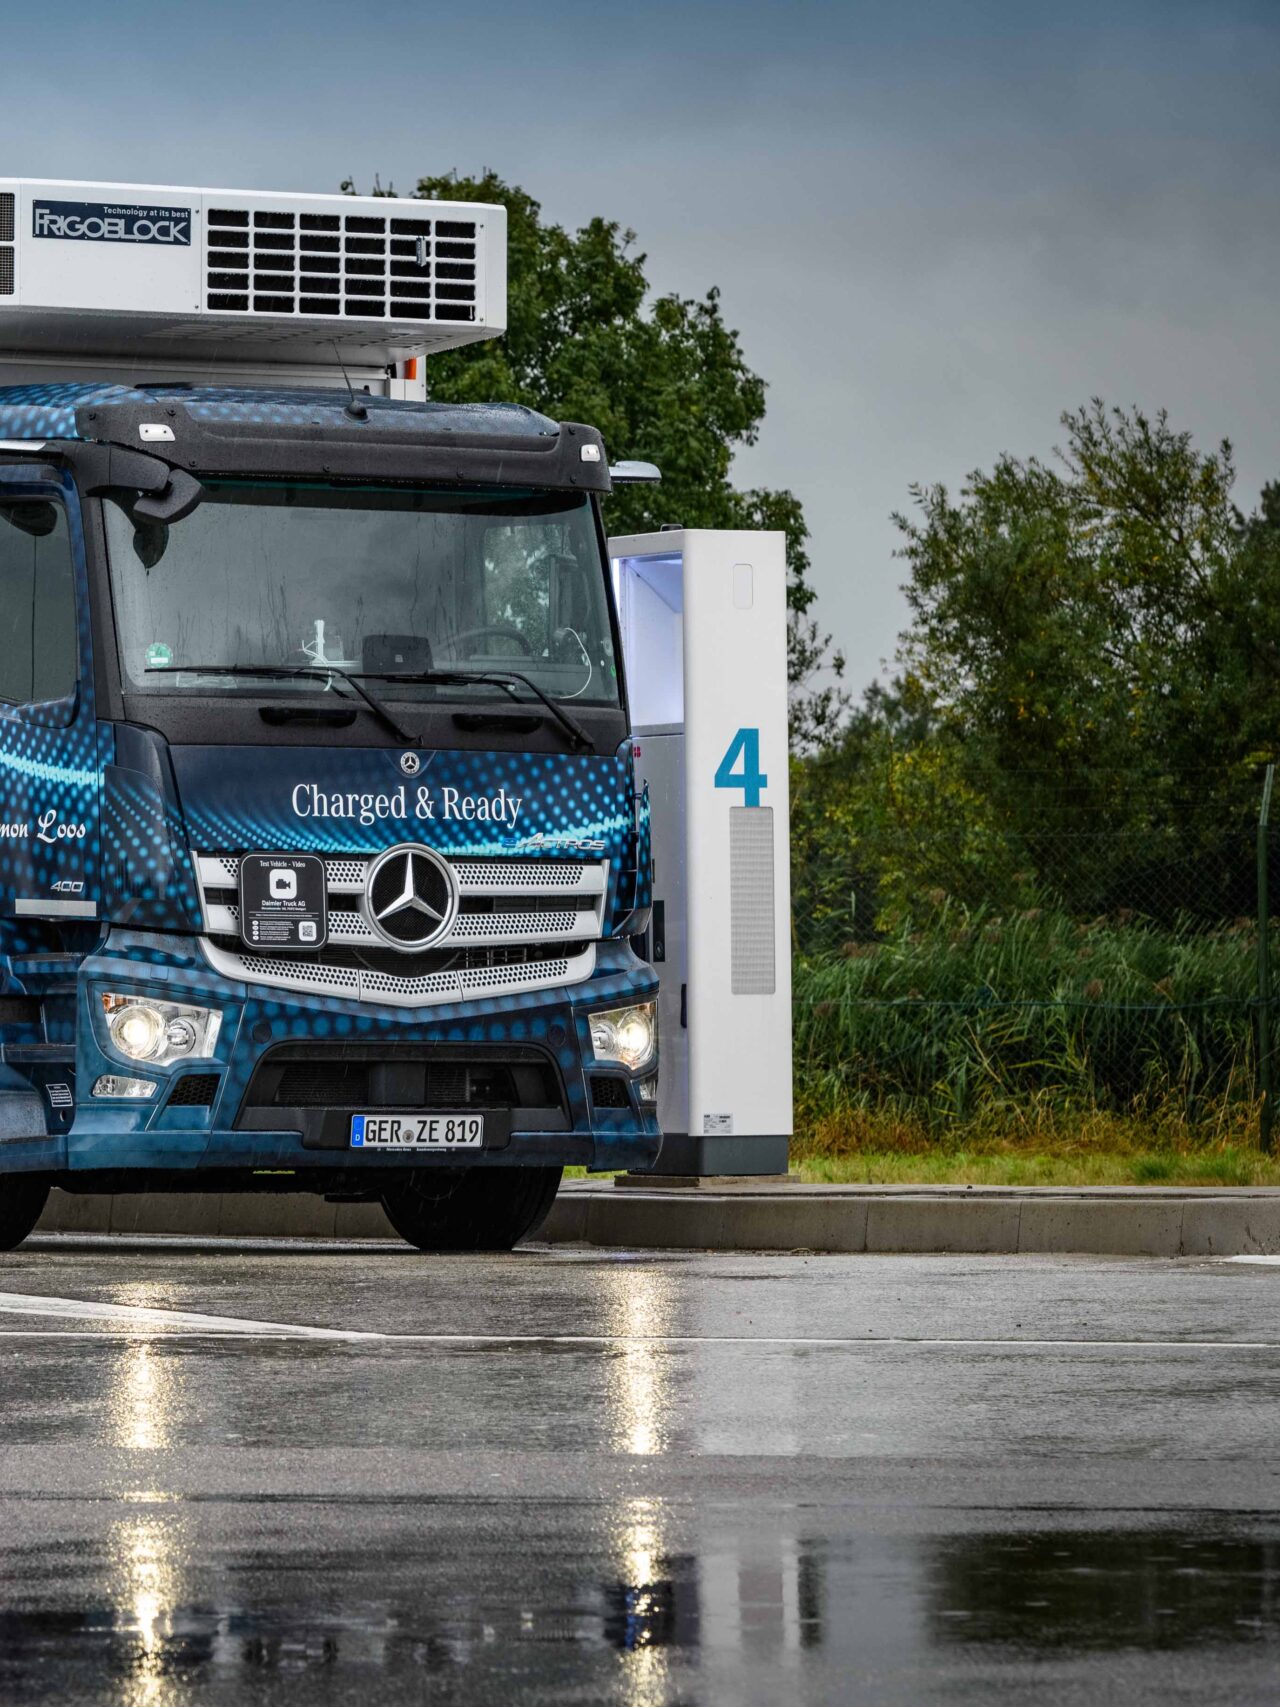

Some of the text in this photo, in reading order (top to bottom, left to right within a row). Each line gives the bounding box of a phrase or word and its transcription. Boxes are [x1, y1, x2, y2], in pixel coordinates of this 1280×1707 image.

[35, 208, 189, 243] FRIGOBLOCK
[103, 206, 147, 217] Technology
[159, 209, 169, 217] its
[171, 210, 188, 218] best
[714, 728, 768, 807] 4
[291, 783, 522, 828] Charged & Ready
[36, 809, 86, 844] Loos
[49, 880, 84, 892] 400
[355, 1133, 361, 1141] D
[365, 1120, 480, 1143] GER ZE 819
